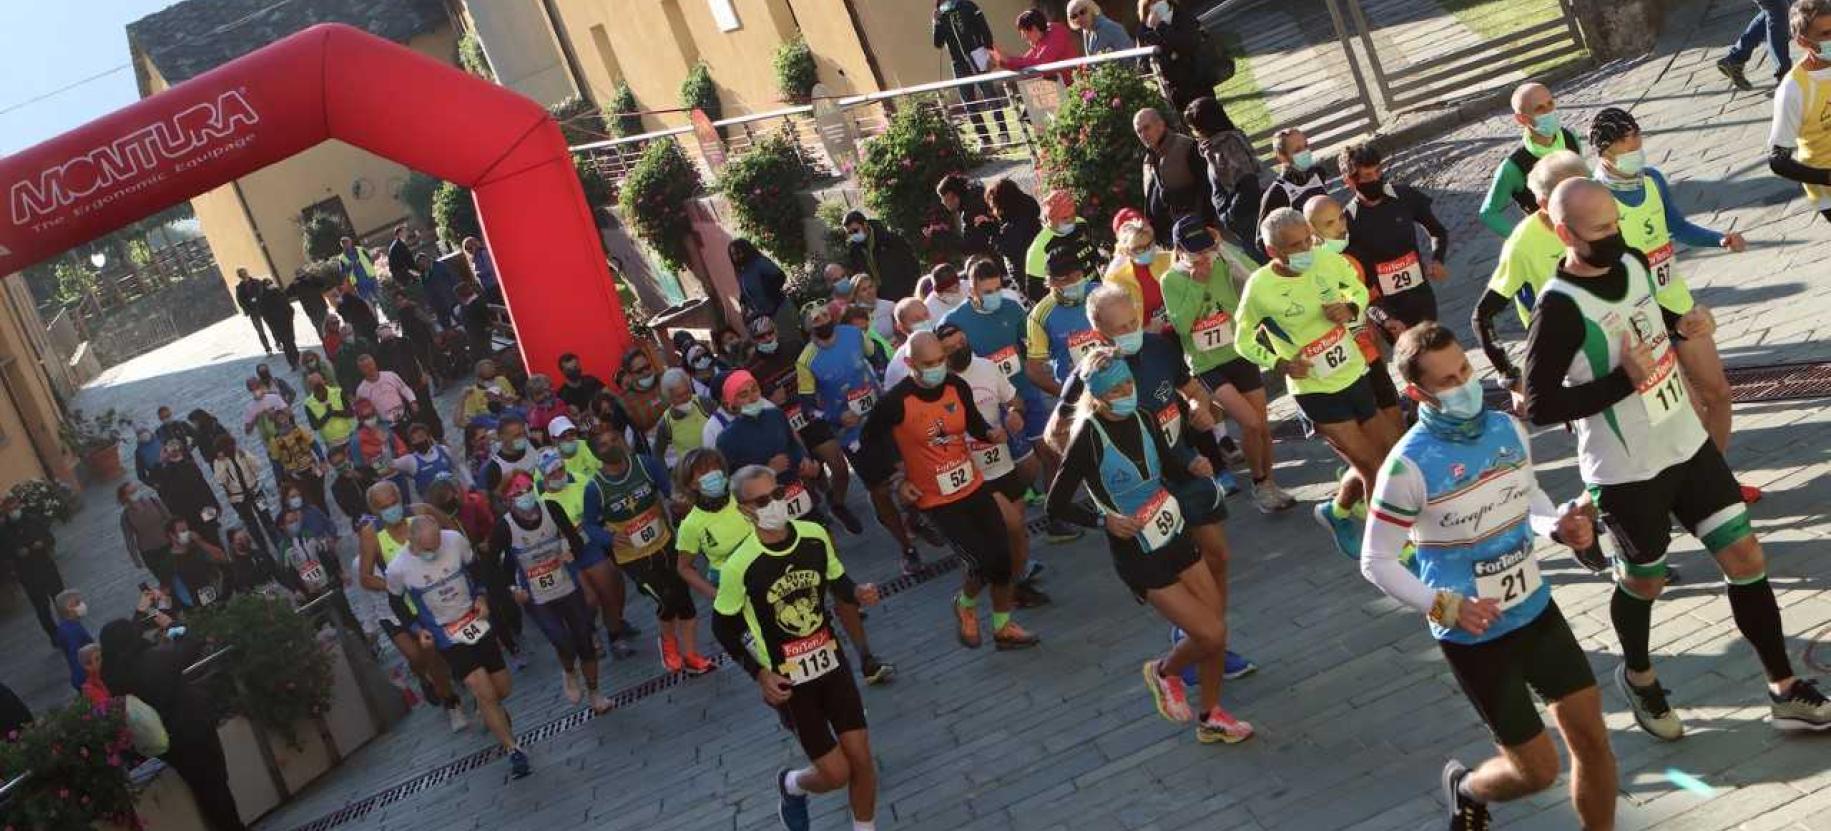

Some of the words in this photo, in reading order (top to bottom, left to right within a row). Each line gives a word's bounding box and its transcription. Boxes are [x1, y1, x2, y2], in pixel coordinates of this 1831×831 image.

[11, 89, 260, 226] MONTURA
[31, 213, 65, 233] The
[73, 172, 168, 219] Ergonomic
[175, 133, 257, 173] Equipage
[1391, 270, 1412, 290] 29
[1656, 262, 1671, 287] 67
[1203, 328, 1221, 346] 77
[1325, 345, 1347, 368] 62
[984, 446, 1000, 465] 32
[950, 467, 968, 488] 52
[787, 496, 802, 515] 47
[1156, 509, 1174, 536] 59
[641, 525, 656, 543] 60
[538, 573, 555, 589] 63
[1501, 567, 1527, 603] 21
[462, 623, 481, 640] 64
[798, 648, 831, 677] 113
